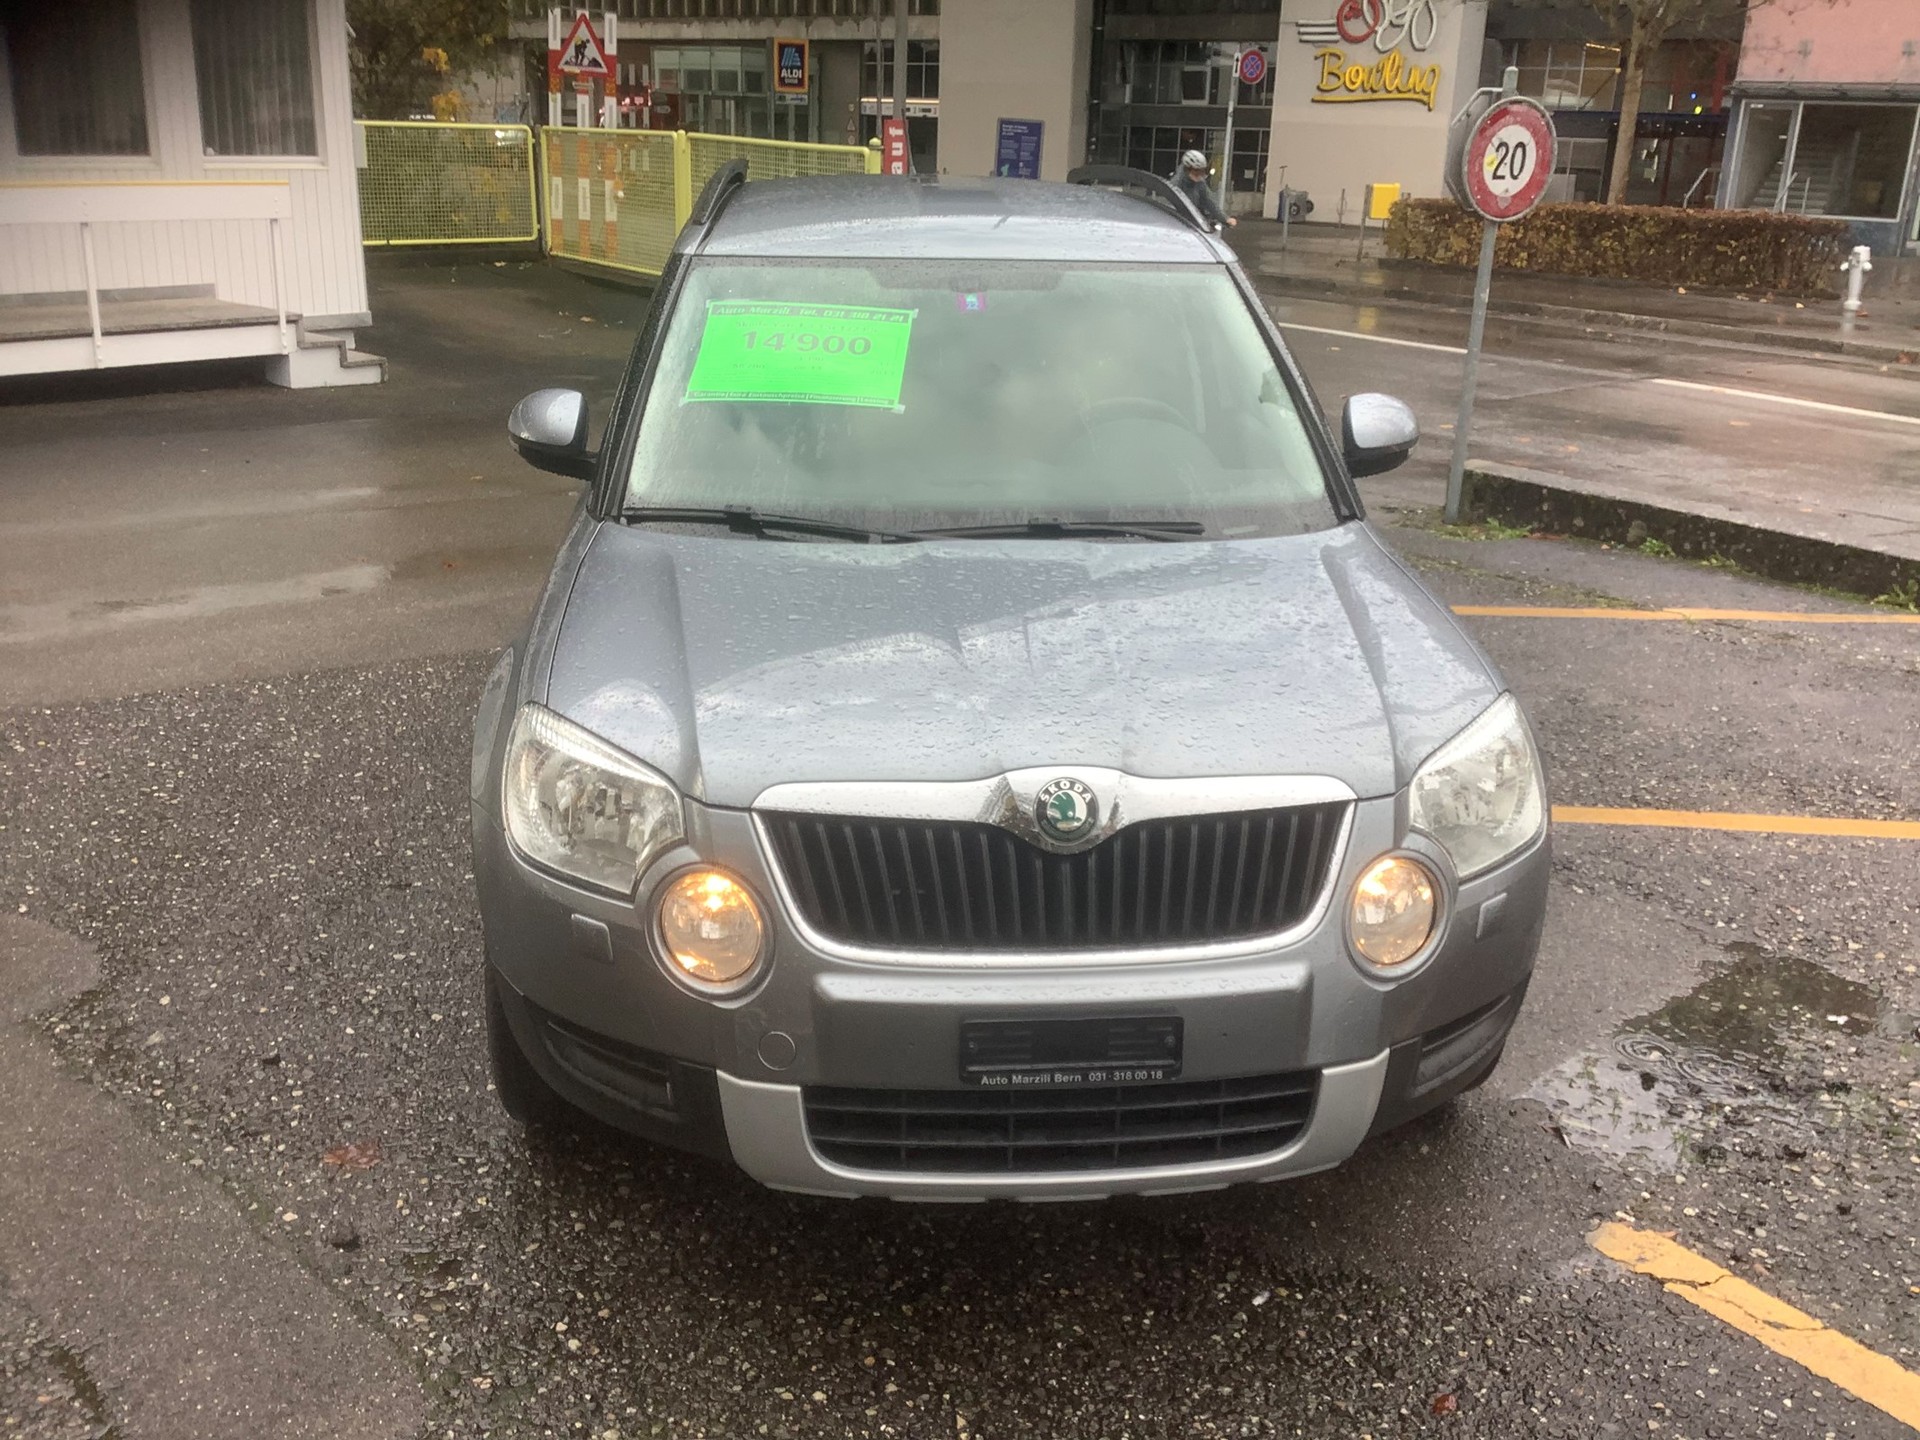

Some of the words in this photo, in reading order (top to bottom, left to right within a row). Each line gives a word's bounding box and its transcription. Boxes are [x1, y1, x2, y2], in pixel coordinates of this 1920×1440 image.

[781, 68, 802, 79] ALDI
[1312, 48, 1440, 111] Bowling
[1492, 141, 1527, 180] 20
[743, 330, 872, 355] 14'900
[981, 1075, 1008, 1085] Auto
[1012, 1073, 1051, 1084] Marzili
[1054, 1073, 1082, 1083] Bern
[1088, 1072, 1106, 1082] 031
[1113, 1071, 1132, 1081] 318
[1134, 1070, 1148, 1080] 00
[1150, 1070, 1163, 1080] 18
